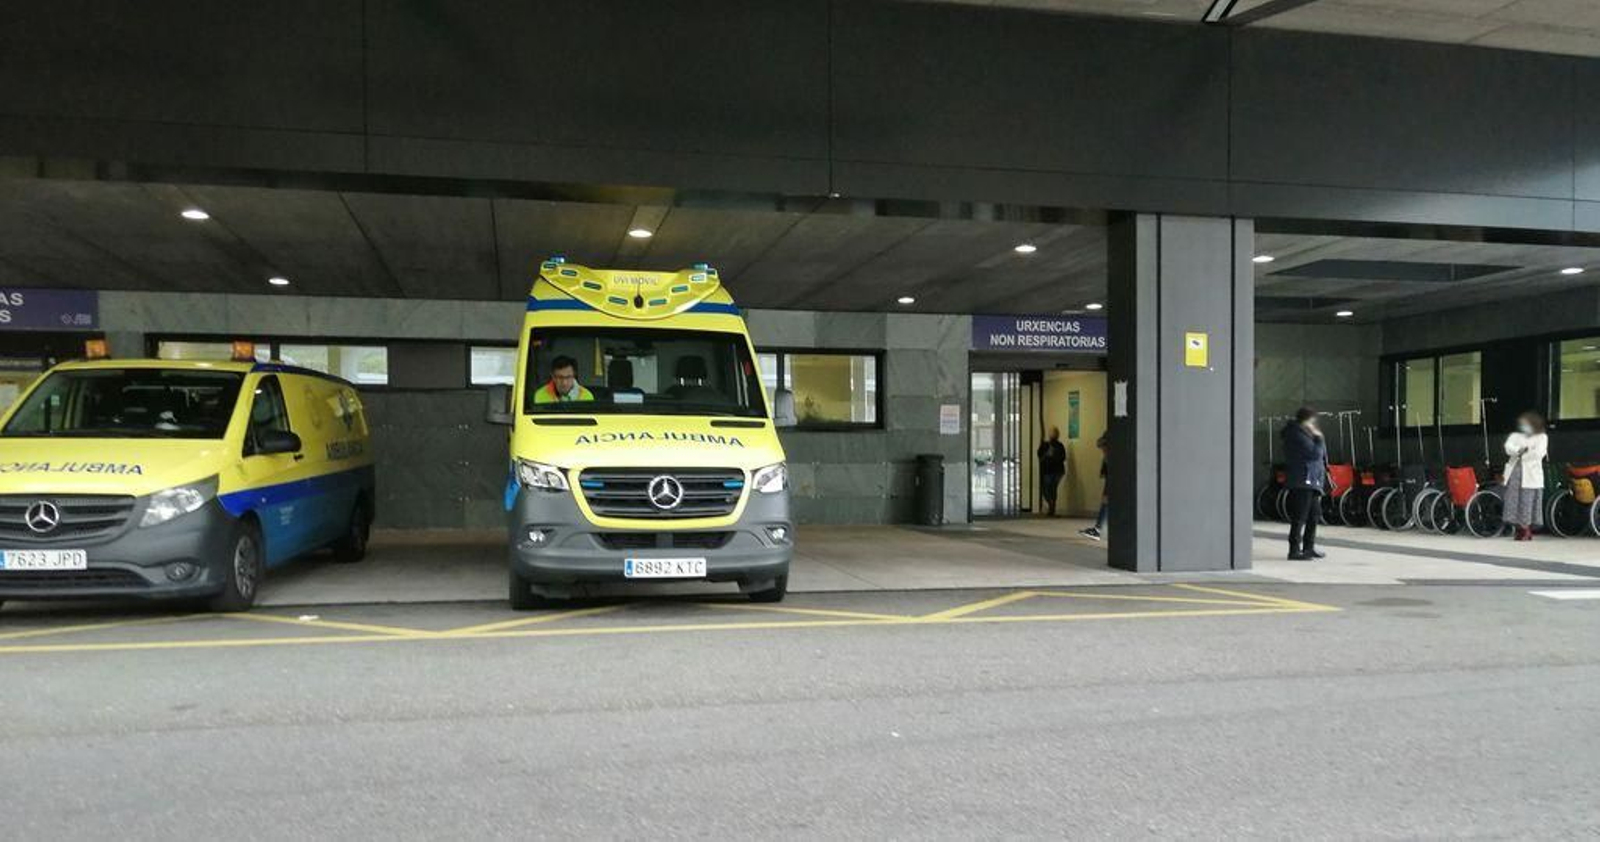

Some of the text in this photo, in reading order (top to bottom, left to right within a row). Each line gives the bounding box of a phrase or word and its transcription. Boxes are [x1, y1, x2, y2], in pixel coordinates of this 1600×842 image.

[1016, 320, 1081, 333] URXENCIAS
[990, 334, 1106, 349] NON RESPIRATORIAS
[8, 551, 82, 567] 7623 JPD
[635, 561, 703, 574] 6892 KTC
